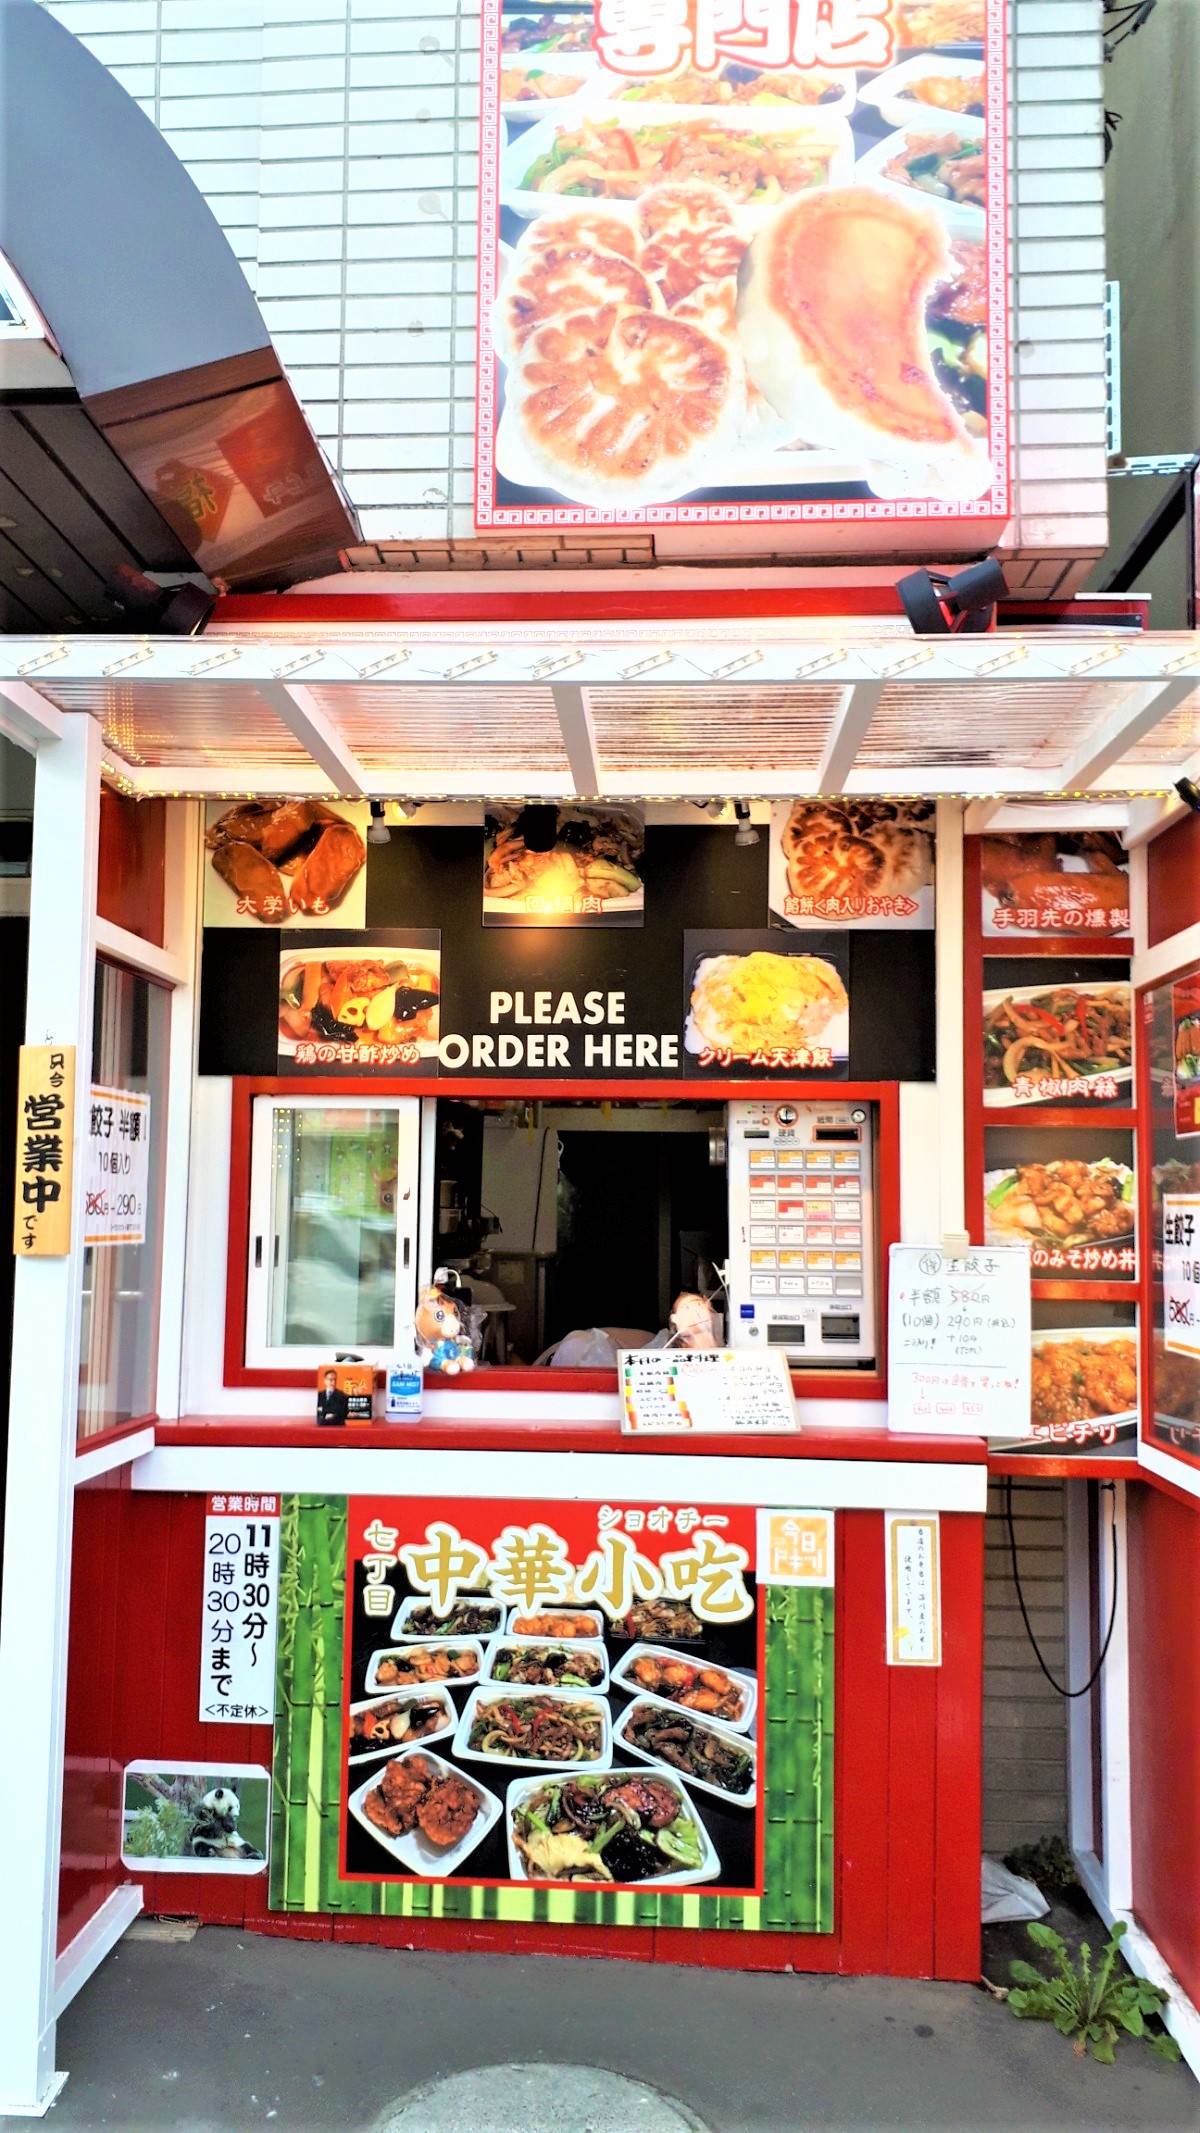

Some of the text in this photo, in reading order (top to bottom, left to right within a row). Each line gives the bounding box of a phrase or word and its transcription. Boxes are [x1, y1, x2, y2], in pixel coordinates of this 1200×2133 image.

[236, 895, 331, 915] 大学いも
[490, 990, 626, 1025] PLEASE
[294, 1044, 421, 1065] 鶏の甘酢炒め
[438, 1033, 679, 1068] ORDER HERE
[698, 1046, 834, 1068] クリーム天津飯
[89, 1103, 114, 1139] 餃子
[22, 1093, 65, 1213] 営業中
[98, 1151, 131, 1175] 10個入り
[21, 1214, 38, 1250] です
[1164, 1213, 1195, 1247] 生餃子
[1029, 1248, 1136, 1271] のみそ炒め丼
[1021, 1422, 1118, 1444] エビチリ
[212, 1495, 277, 1513] 営業時間
[598, 1505, 730, 1533] ショオチー
[363, 1520, 398, 1617] 七丁目
[400, 1521, 754, 1623] 中華小吃
[206, 1532, 242, 1697] 20時30分まで
